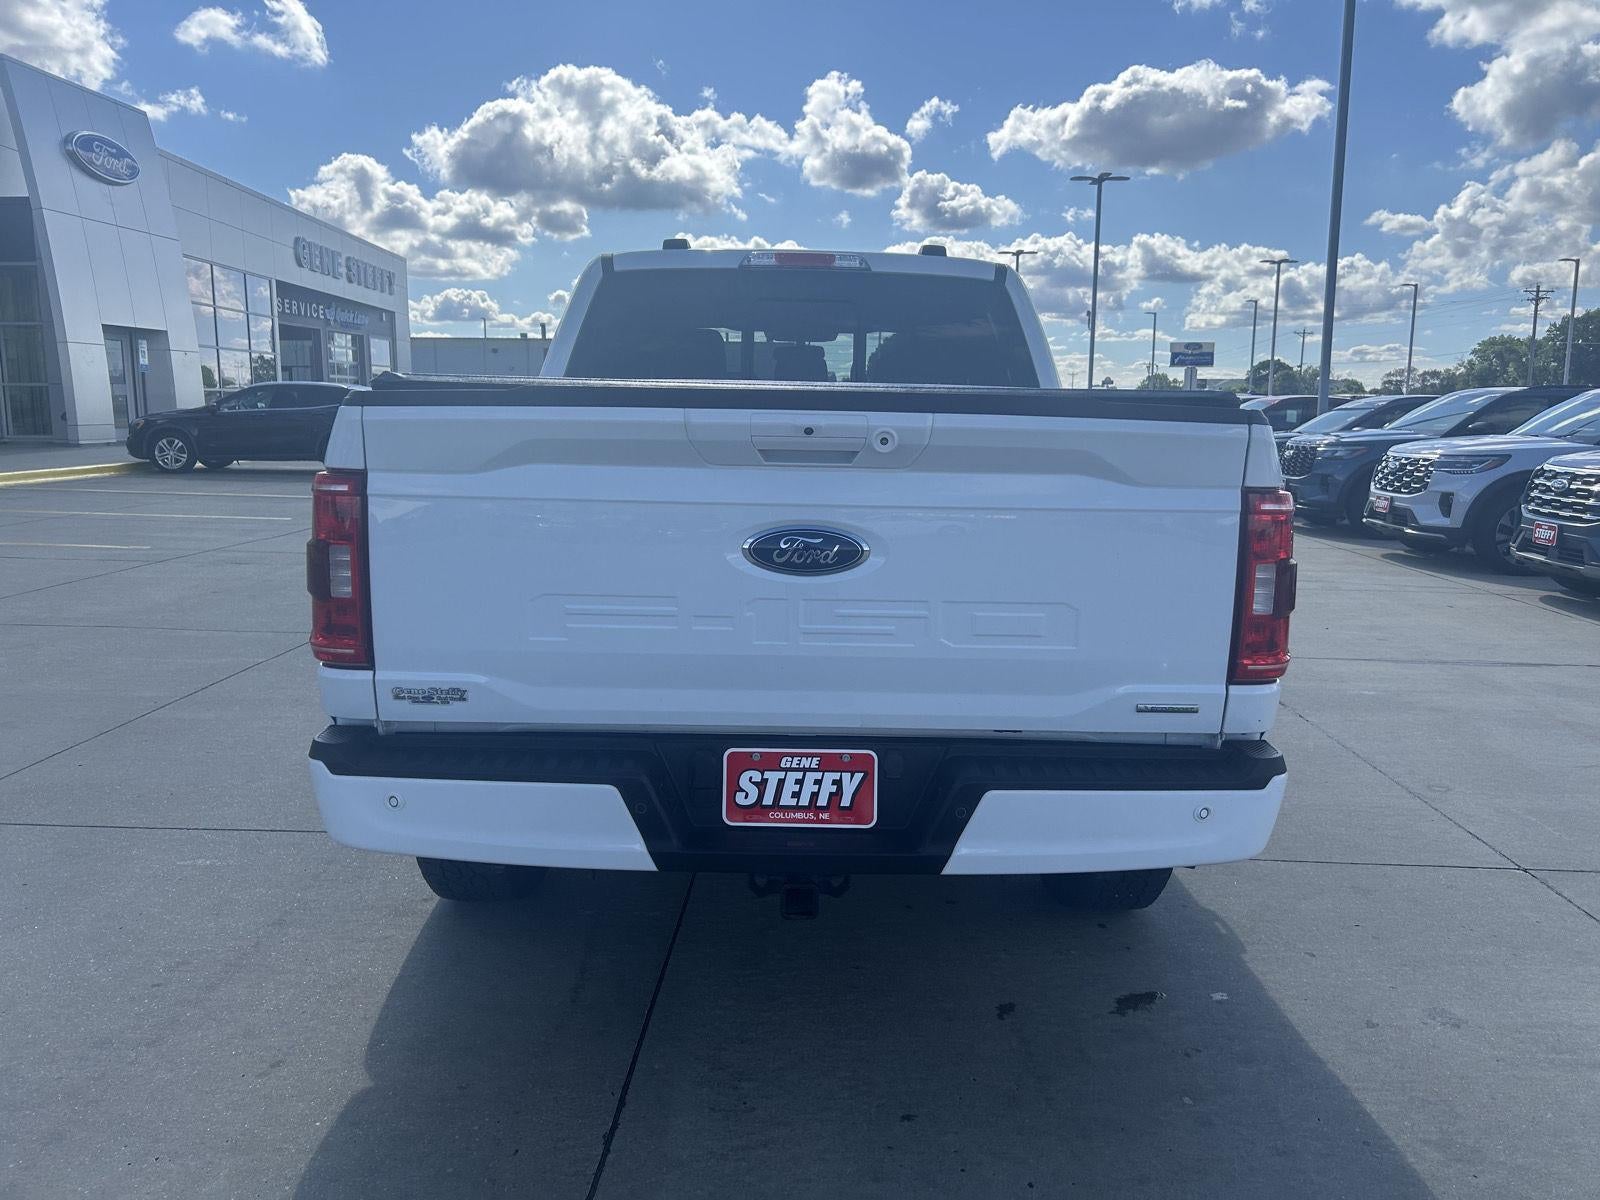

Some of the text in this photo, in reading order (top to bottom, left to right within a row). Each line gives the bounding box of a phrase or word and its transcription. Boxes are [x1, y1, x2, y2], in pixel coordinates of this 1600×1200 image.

[92, 141, 130, 176] Ford
[293, 236, 396, 296] GENE STEFFY
[276, 297, 325, 319] SERVICE
[1534, 528, 1555, 540] STEFFY
[772, 536, 840, 564] Ford
[527, 593, 1079, 650] F-150
[780, 756, 821, 769] GENE
[735, 769, 865, 808] STEFFY
[768, 811, 830, 821] COLUMBUS, NE
